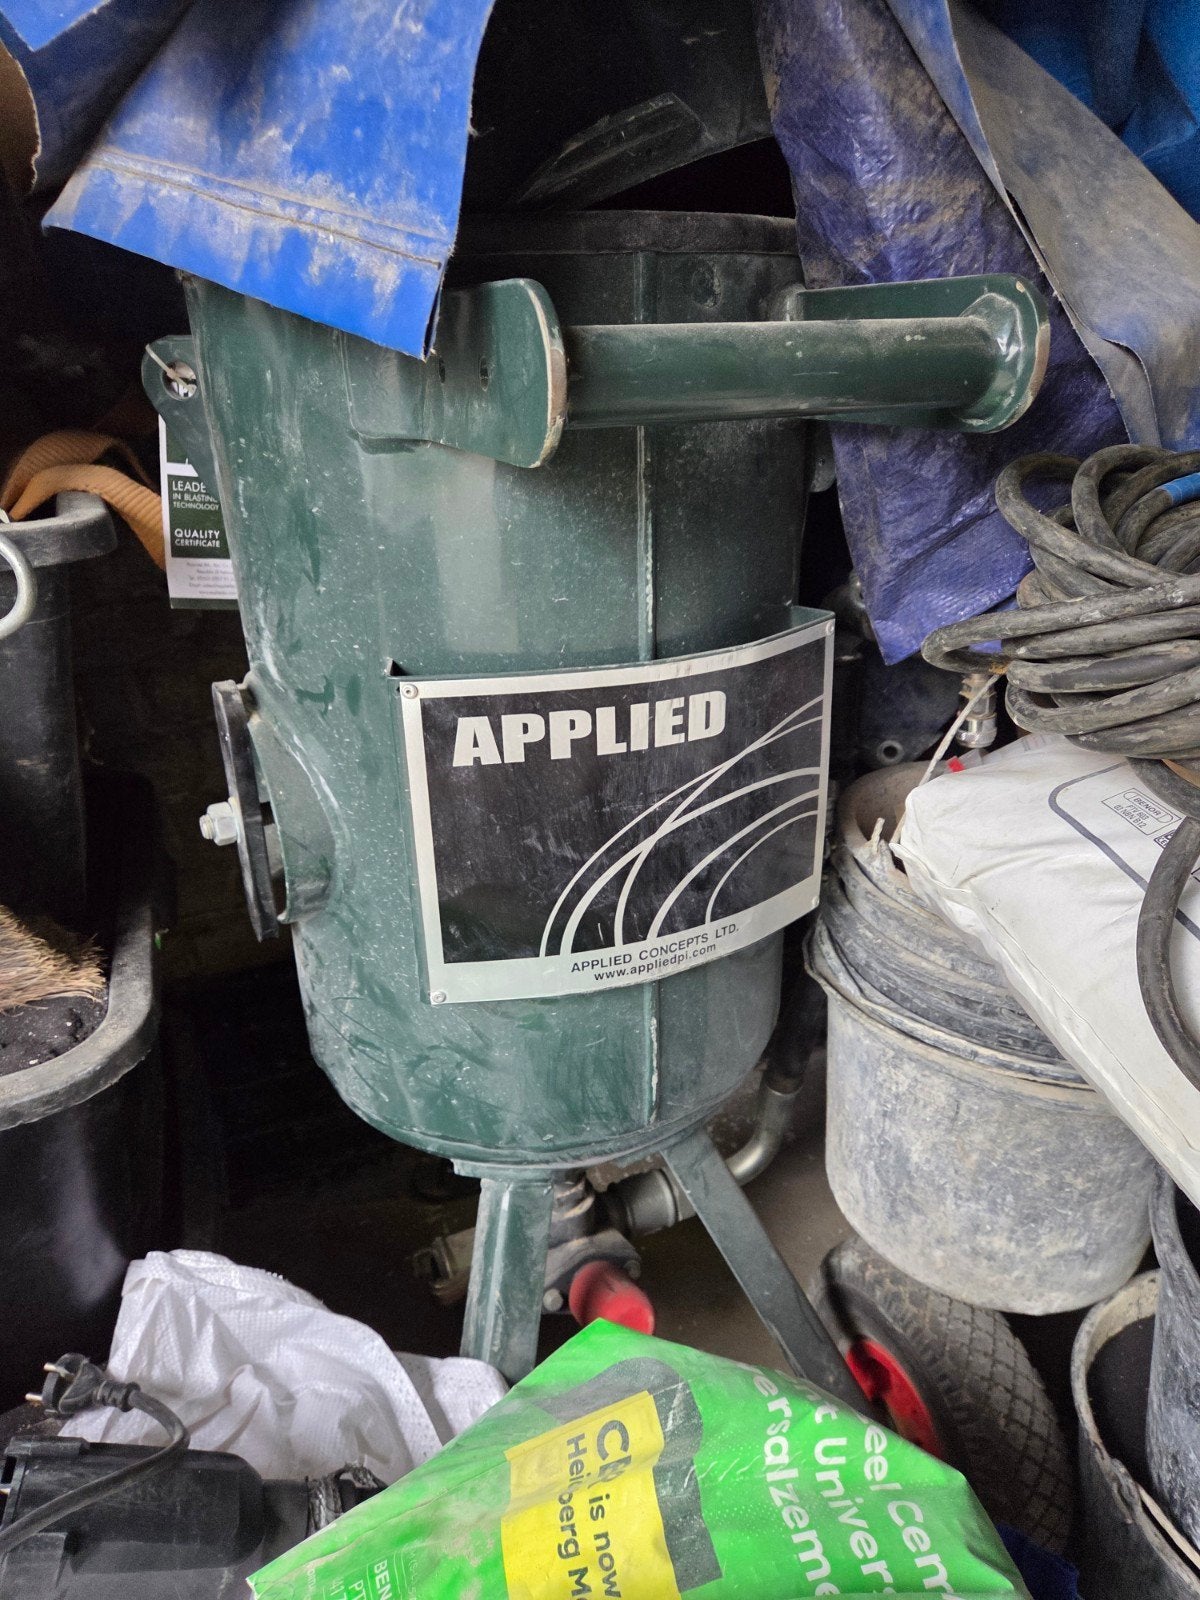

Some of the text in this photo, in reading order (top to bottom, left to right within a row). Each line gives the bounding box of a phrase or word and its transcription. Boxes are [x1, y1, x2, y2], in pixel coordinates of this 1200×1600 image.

[172, 480, 206, 493] LEADE
[183, 493, 218, 503] BLASTIN
[173, 501, 219, 511] TECHNOLOGY
[174, 528, 220, 539] QUALITY
[174, 538, 221, 548] CERTIFICATE
[452, 690, 727, 767] APPLIED
[1133, 797, 1161, 816] BENOR
[571, 923, 740, 973] APPLIED CONCEPTS LTD.
[594, 943, 717, 981] www.appliedpi.com
[859, 1415, 902, 1492] eel
[588, 1493, 611, 1521] is
[814, 1437, 897, 1595] Univer
[593, 1531, 622, 1599] now
[567, 1566, 593, 1600] M
